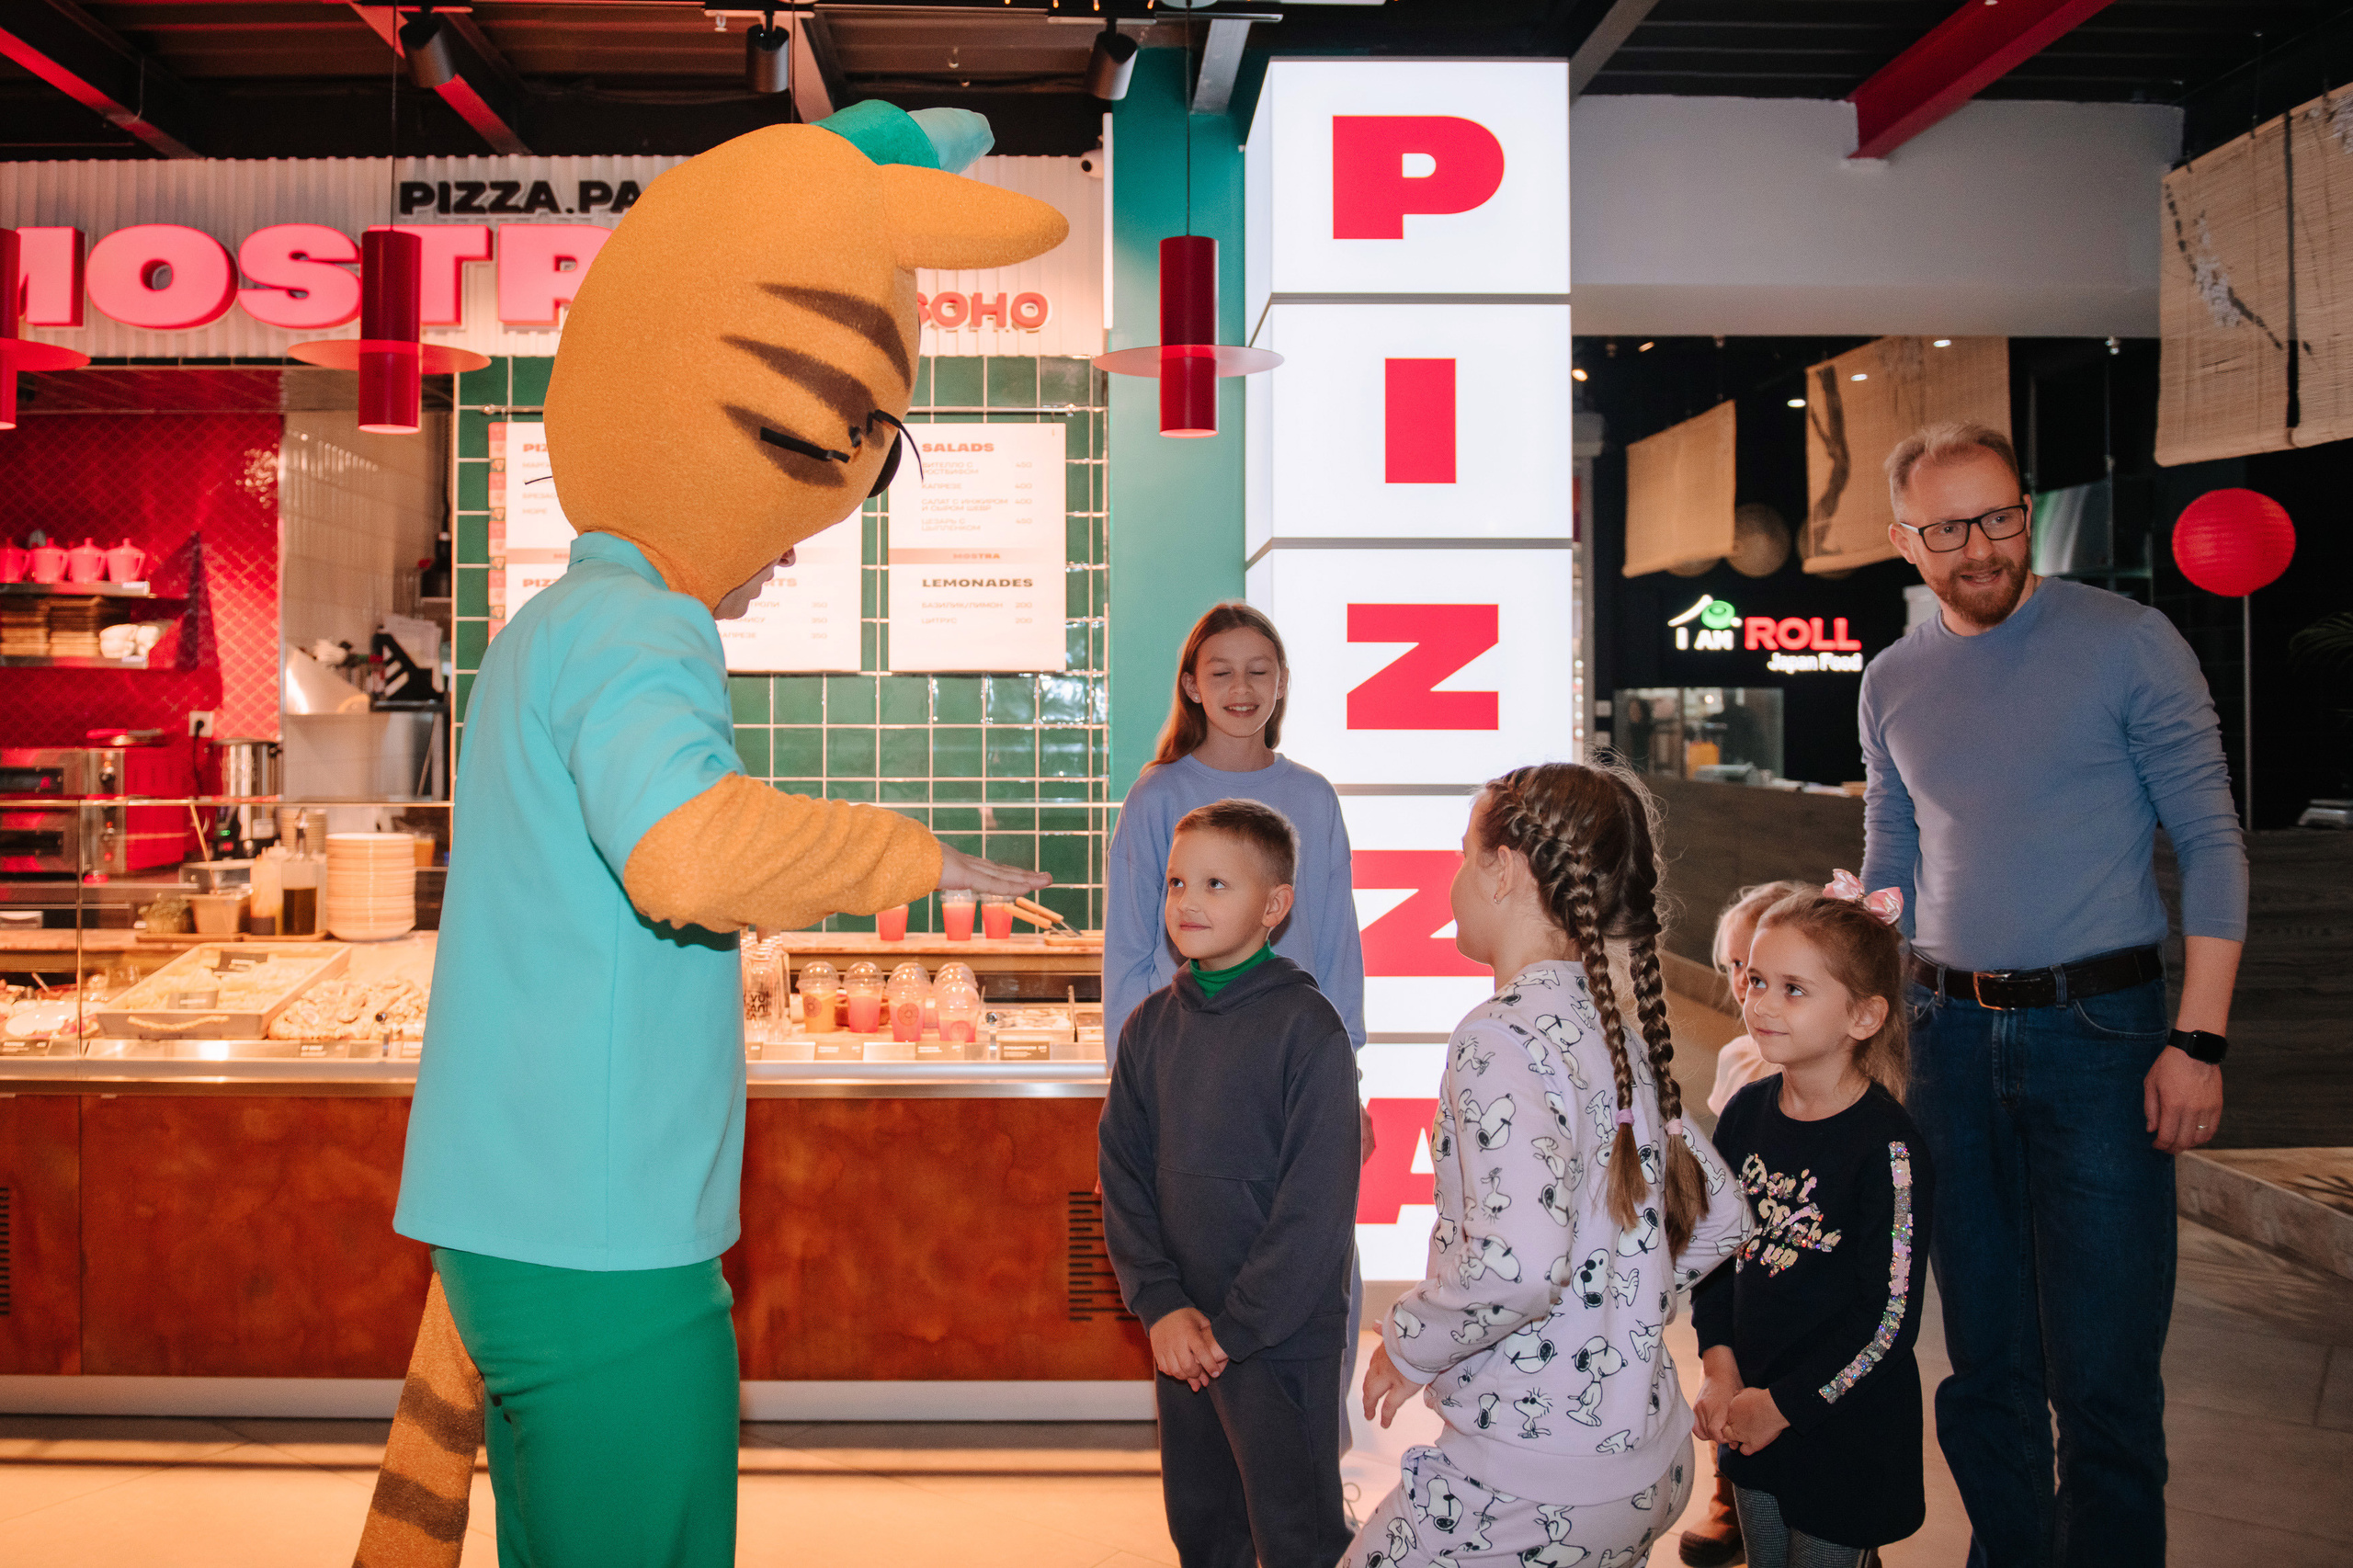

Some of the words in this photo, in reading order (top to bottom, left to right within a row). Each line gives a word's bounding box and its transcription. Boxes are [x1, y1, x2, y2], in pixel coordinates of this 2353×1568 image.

[399, 180, 643, 214] PIZZA.PA
[16, 223, 614, 329] OSTR
[922, 443, 995, 452] SALADS
[523, 579, 560, 587] PIZ
[922, 578, 1033, 587] LEMONADES
[1676, 627, 1688, 650] I
[1694, 630, 1734, 651] AM
[1745, 616, 1862, 651] ROLL
[1767, 652, 1819, 674] Japan
[1818, 652, 1863, 672] Food
